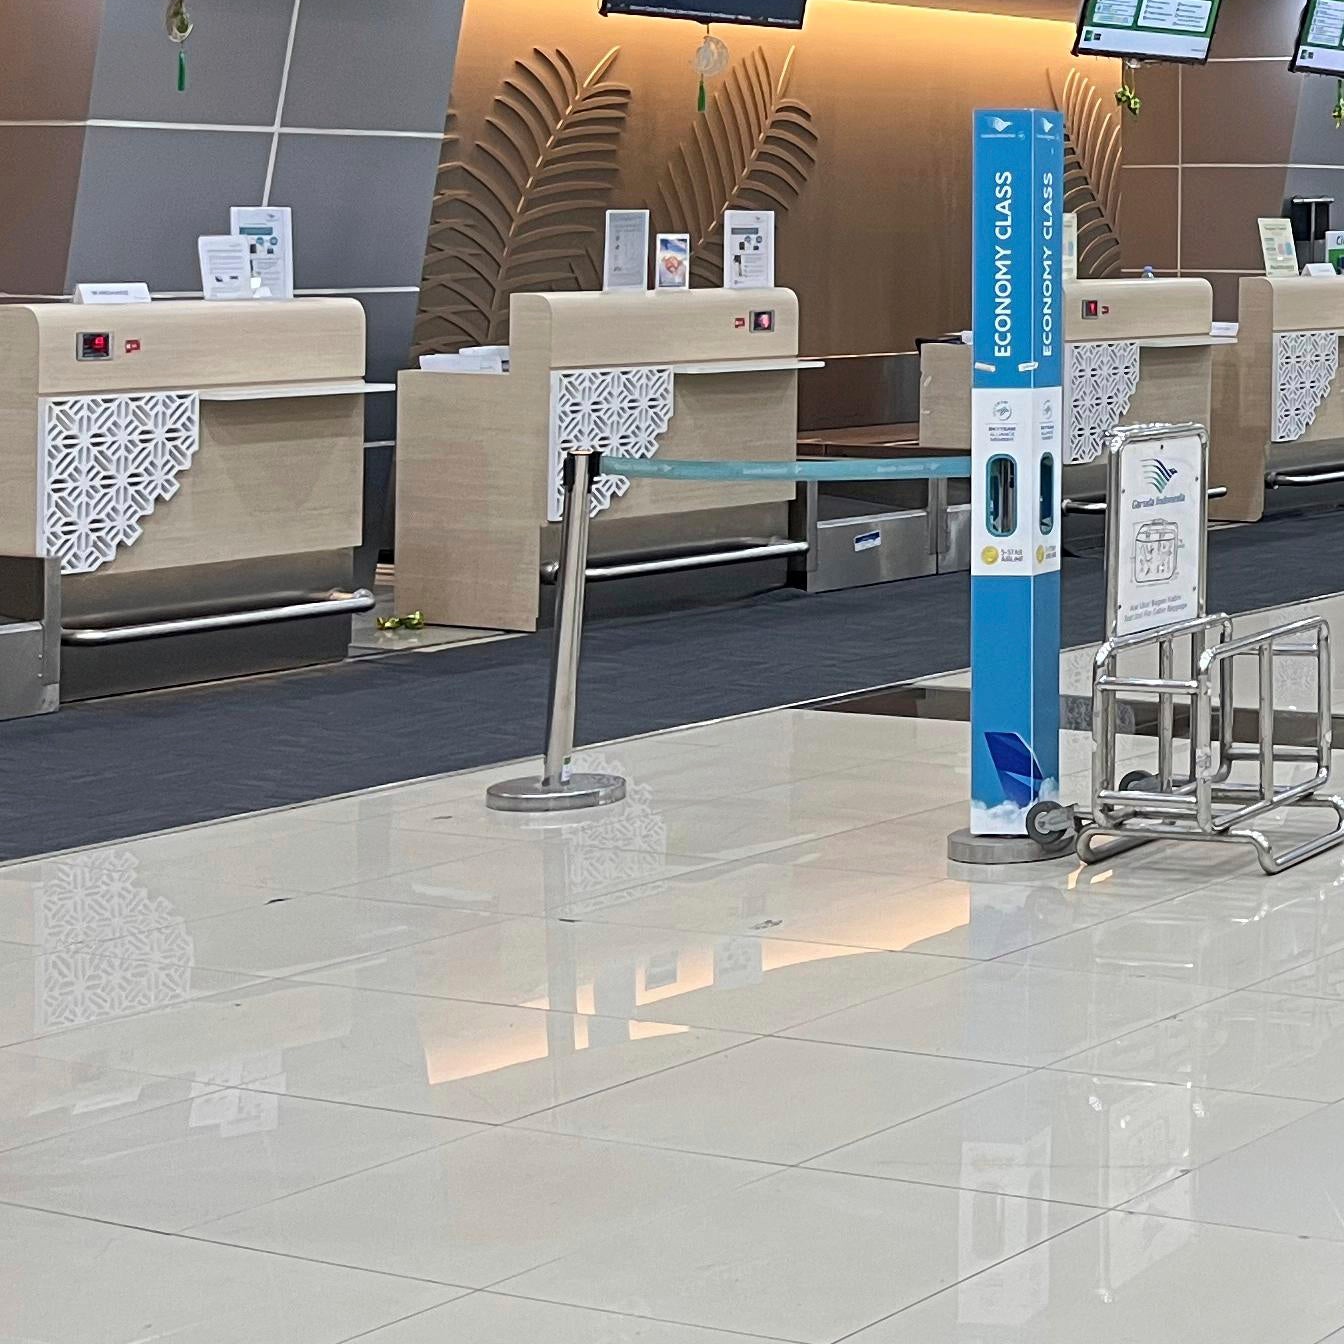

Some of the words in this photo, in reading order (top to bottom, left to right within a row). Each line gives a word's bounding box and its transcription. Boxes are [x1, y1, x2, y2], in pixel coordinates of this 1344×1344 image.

[995, 171, 1012, 240] CLASS
[1042, 171, 1053, 240] CLASS
[995, 245, 1012, 357] ECONOMY
[1042, 246, 1053, 357] ECONOMY
